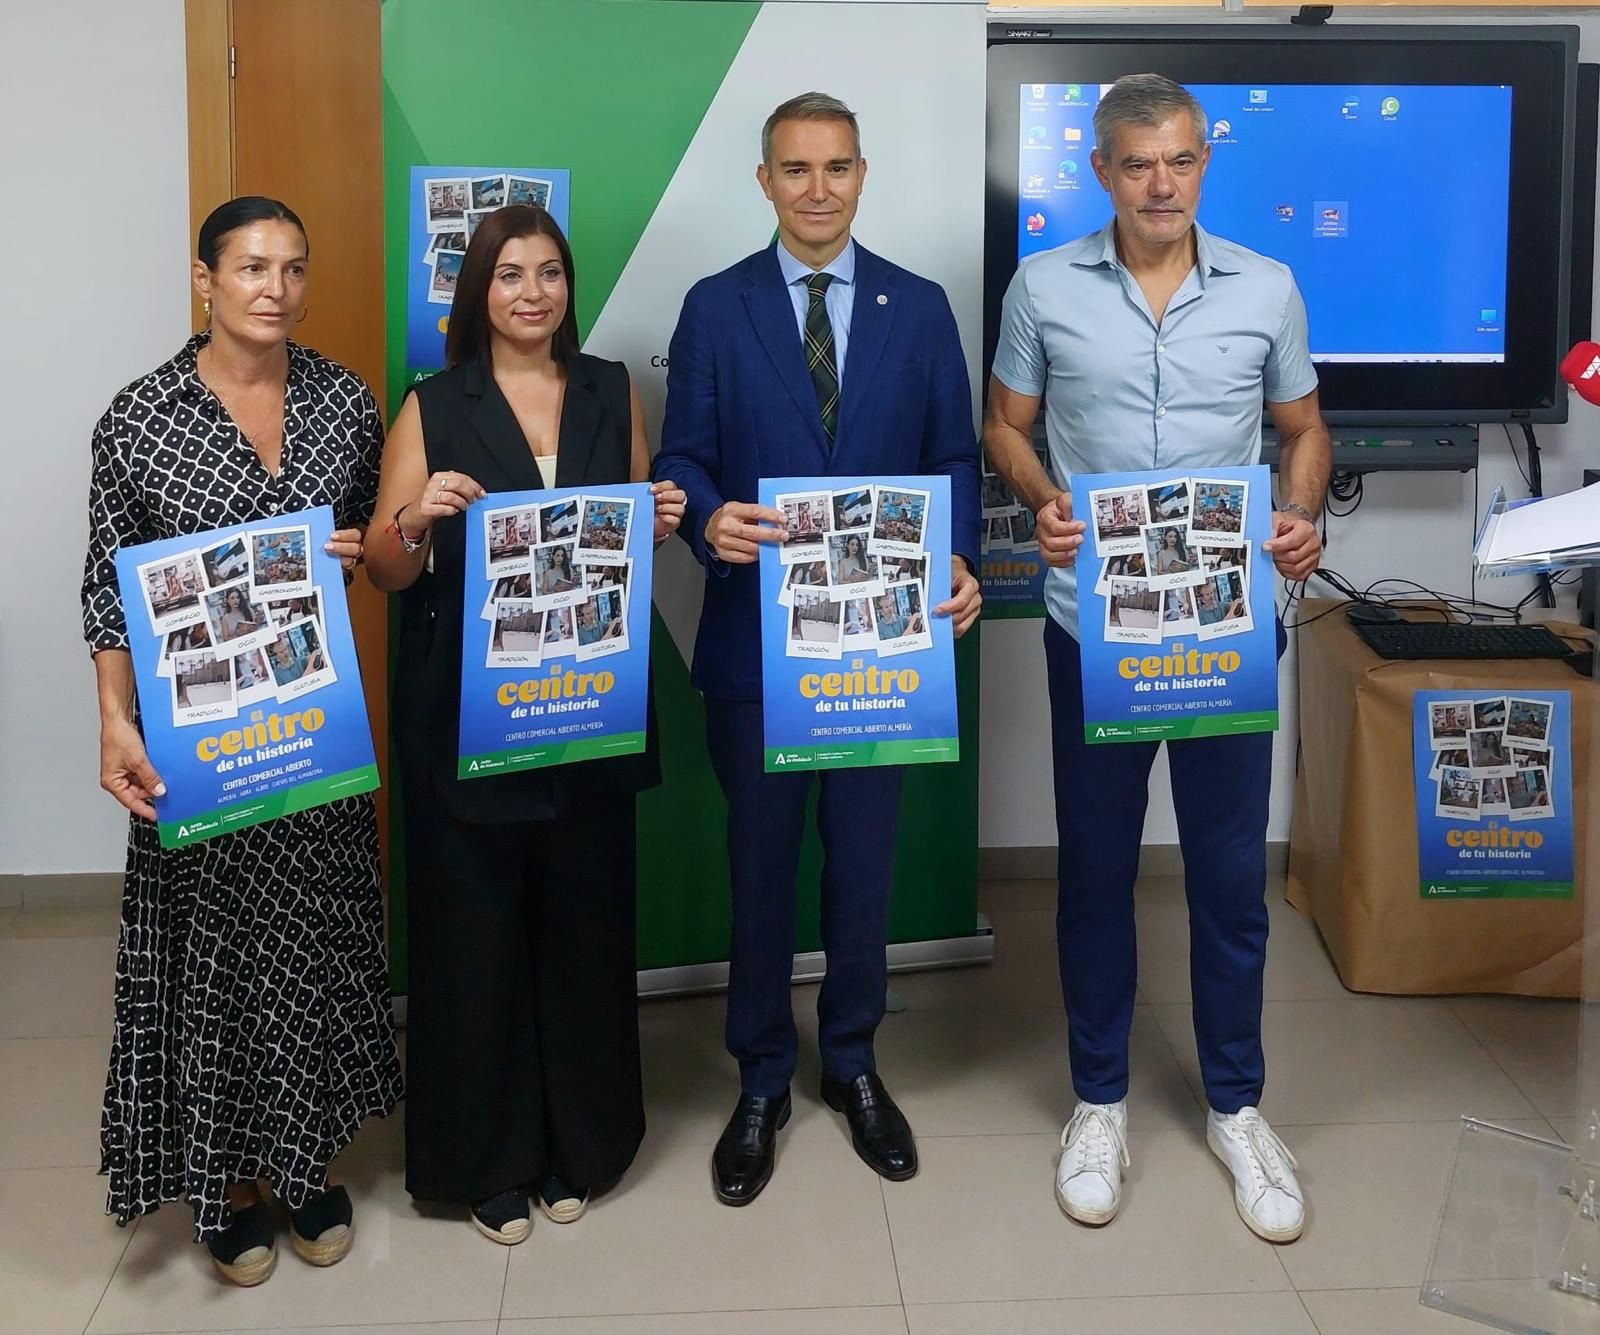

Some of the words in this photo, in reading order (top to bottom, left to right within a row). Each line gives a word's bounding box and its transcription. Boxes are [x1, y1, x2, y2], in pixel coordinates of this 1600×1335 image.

[981, 560, 1040, 577] ntro
[1118, 648, 1240, 680] centro
[496, 670, 614, 706] centro
[800, 666, 920, 698] centro
[1134, 680, 1152, 692] de
[1154, 680, 1169, 690] tu
[1172, 676, 1226, 689] historia
[511, 706, 528, 718] de
[530, 704, 544, 716] tu
[548, 698, 600, 714] historia
[815, 700, 832, 712] de
[834, 700, 849, 711] tu
[852, 696, 906, 711] historia
[1130, 704, 1152, 713] CENTRO
[1152, 702, 1184, 712] COMERCIAL
[1184, 700, 1208, 709] ABIERTO
[196, 707, 325, 762] centro
[505, 732, 526, 742] CENTRO
[526, 727, 557, 738] COMERCIAL
[558, 724, 580, 734] ABIERTO
[811, 728, 832, 736] CENTRO
[832, 725, 863, 735] COMERCIAL
[864, 724, 888, 733] ABIERTO
[216, 760, 235, 774] de
[238, 754, 254, 768] tu
[256, 737, 314, 763] historia
[222, 773, 248, 791] CENTRO
[248, 766, 284, 784] COMERCIAL
[285, 758, 312, 773] ABIERTO
[1446, 827, 1544, 848] centro
[1458, 850, 1472, 858] de
[1474, 850, 1486, 858] tu
[1488, 849, 1532, 858] historia
